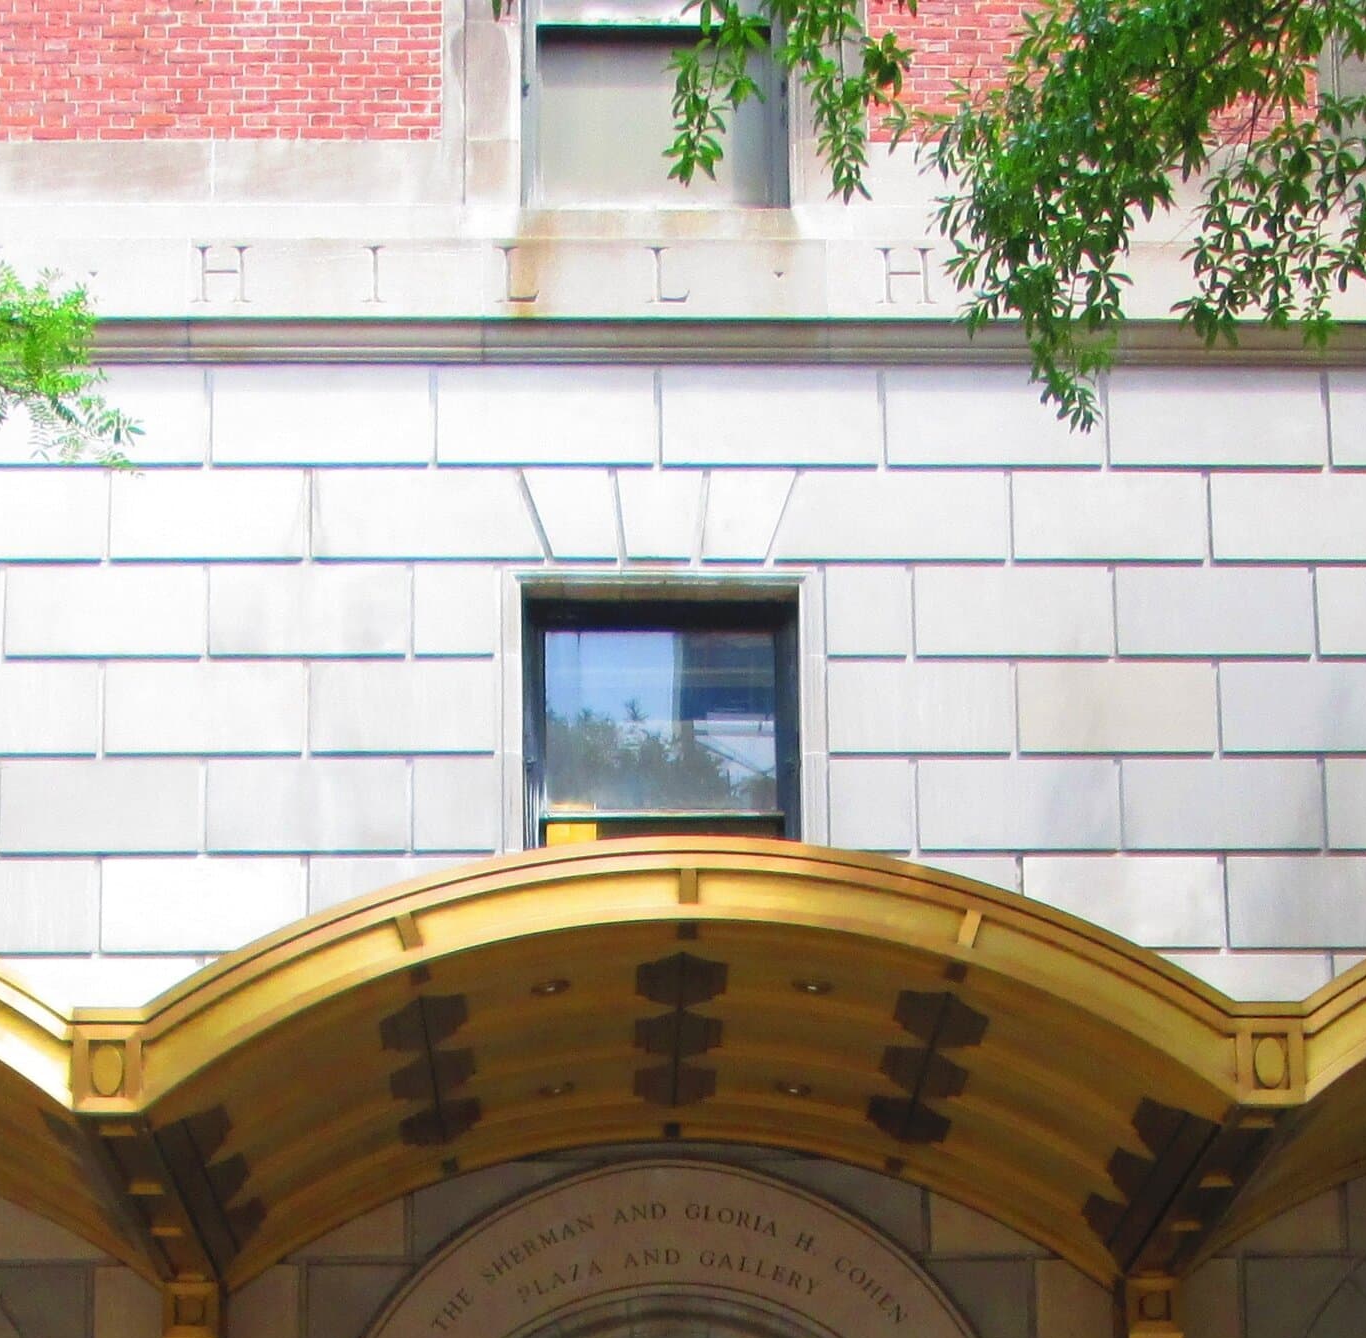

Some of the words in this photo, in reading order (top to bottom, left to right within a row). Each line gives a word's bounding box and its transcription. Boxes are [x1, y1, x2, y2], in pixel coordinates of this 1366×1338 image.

[189, 244, 692, 304] HILL
[431, 1287, 475, 1332] THE
[482, 1214, 596, 1284] SHERMAN
[613, 1201, 667, 1225] AND
[685, 1202, 777, 1237] GLORIA
[795, 1231, 818, 1256] H.
[835, 1255, 908, 1325] COHEN
[516, 1257, 604, 1304] PLAZA
[623, 1248, 680, 1269] AND
[698, 1249, 824, 1296] GALLERY
